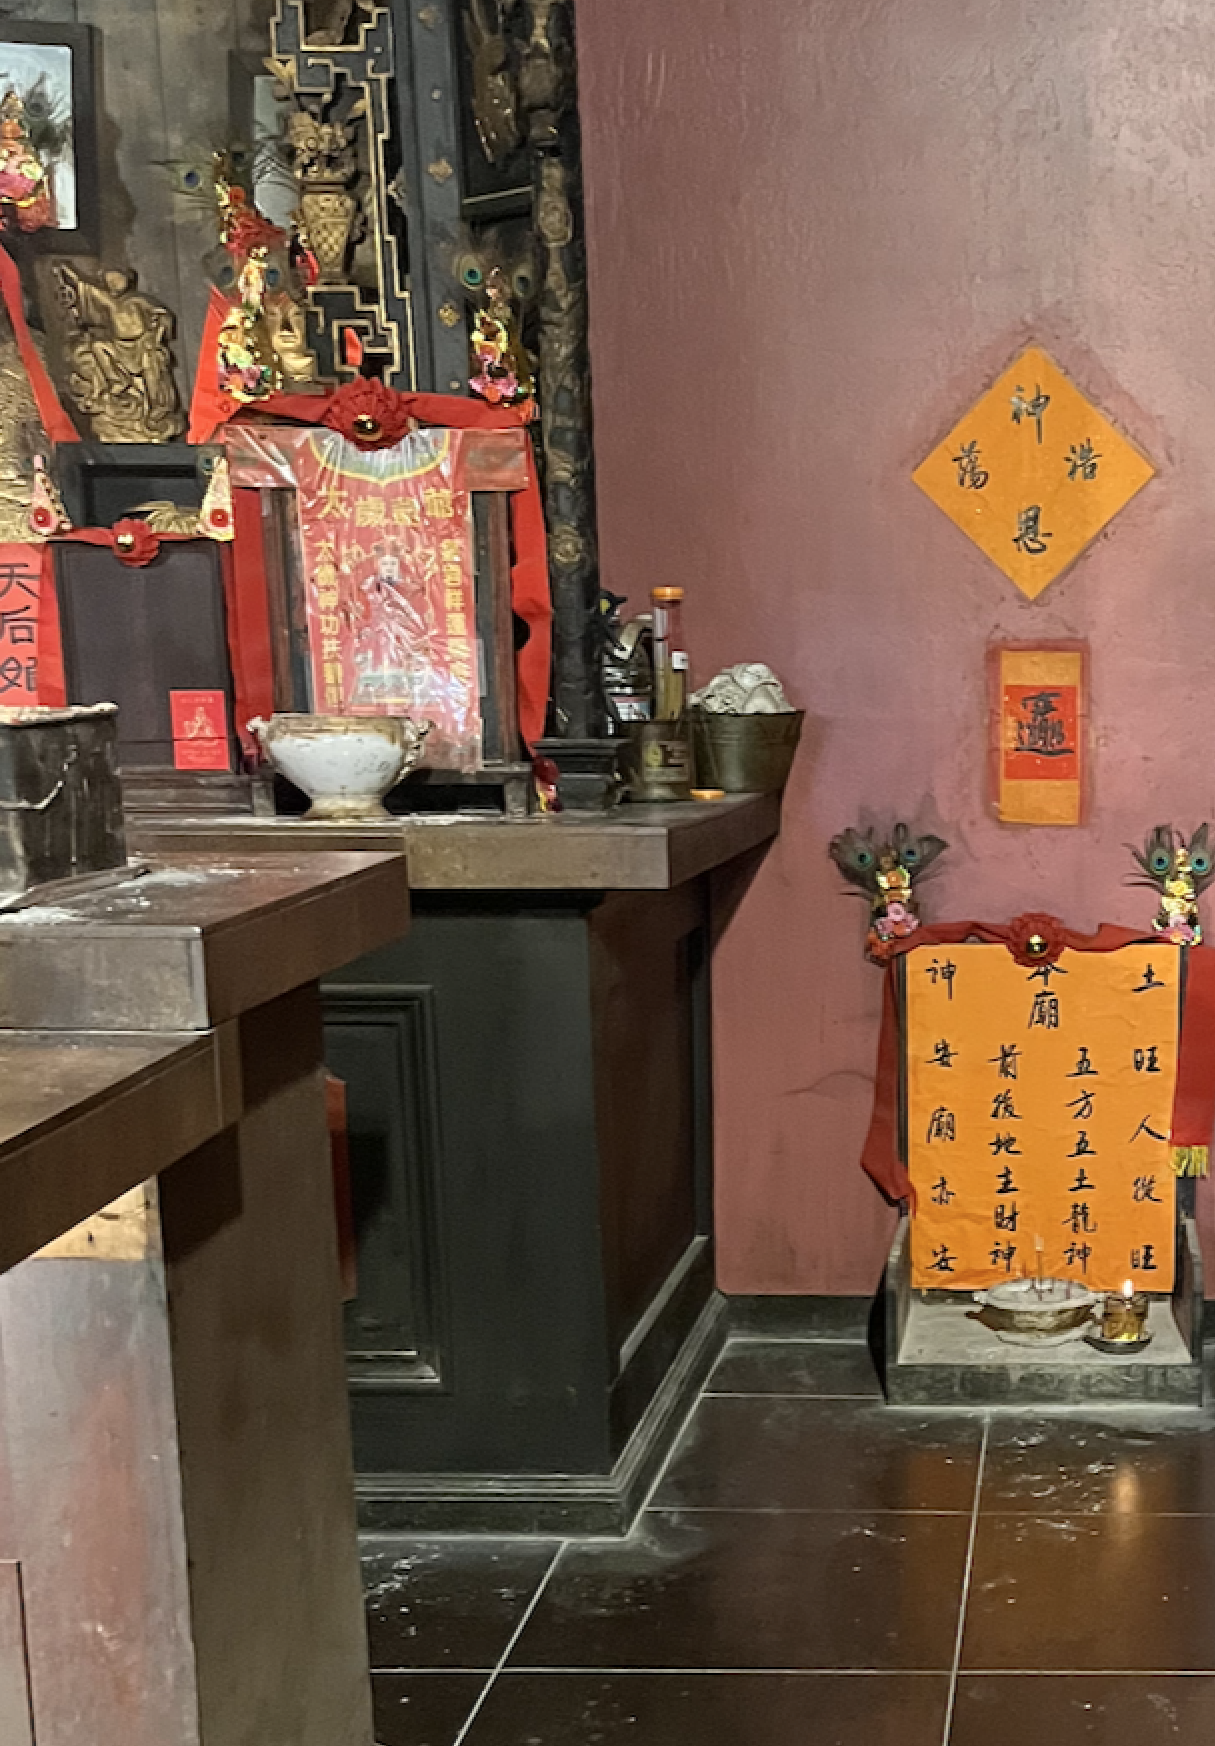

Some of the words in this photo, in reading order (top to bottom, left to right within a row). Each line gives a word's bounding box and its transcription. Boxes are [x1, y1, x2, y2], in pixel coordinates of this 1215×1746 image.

[1009, 383, 1051, 444] 神
[951, 440, 989, 491] 蕩
[1063, 437, 1103, 482] 浩
[1011, 504, 1053, 554] 恩
[987, 1042, 1023, 1273] 前後地主財神
